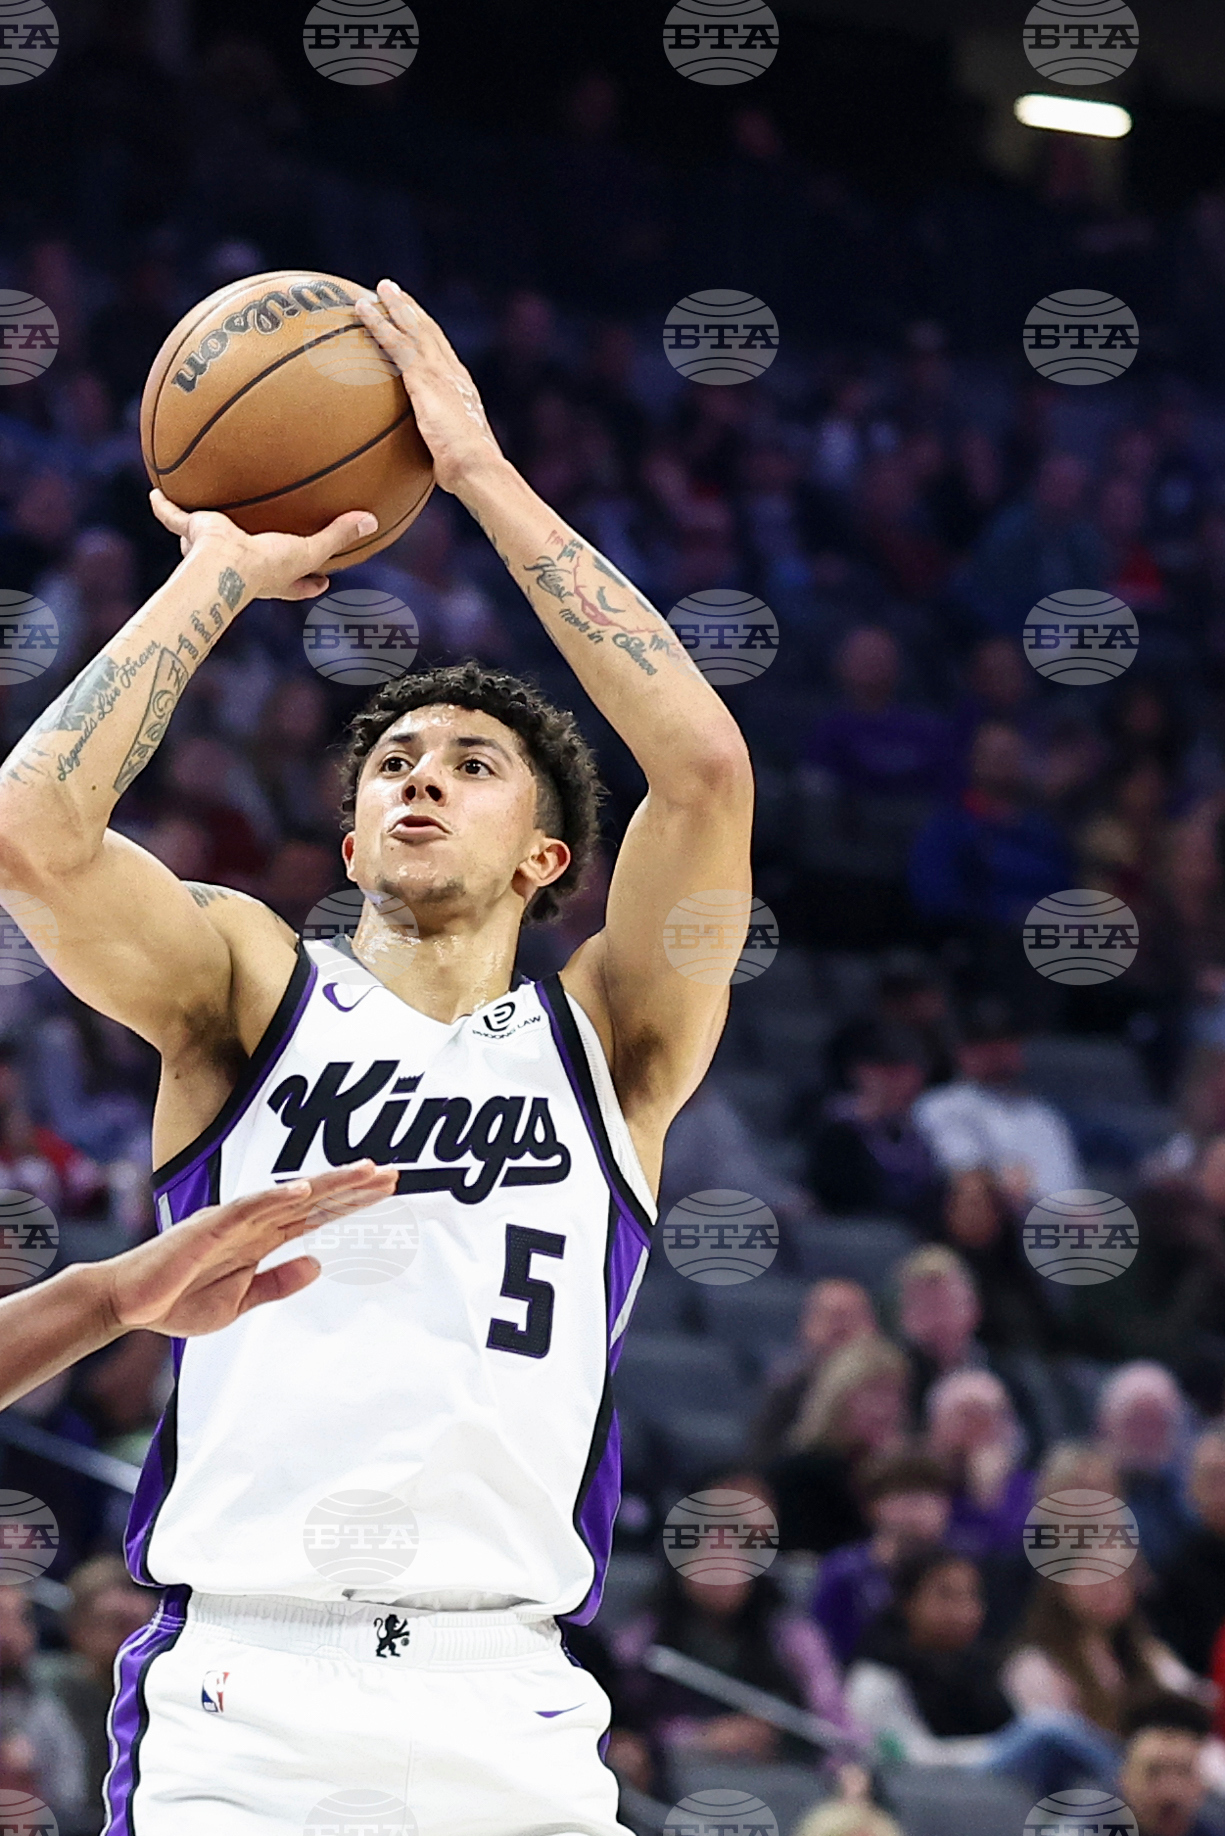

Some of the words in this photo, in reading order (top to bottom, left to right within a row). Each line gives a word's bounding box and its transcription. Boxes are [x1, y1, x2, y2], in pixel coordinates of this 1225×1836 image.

[171, 280, 356, 395] Wilson
[57, 719, 97, 781] Legends
[267, 1059, 572, 1205] Kings
[485, 1223, 567, 1360] 5
